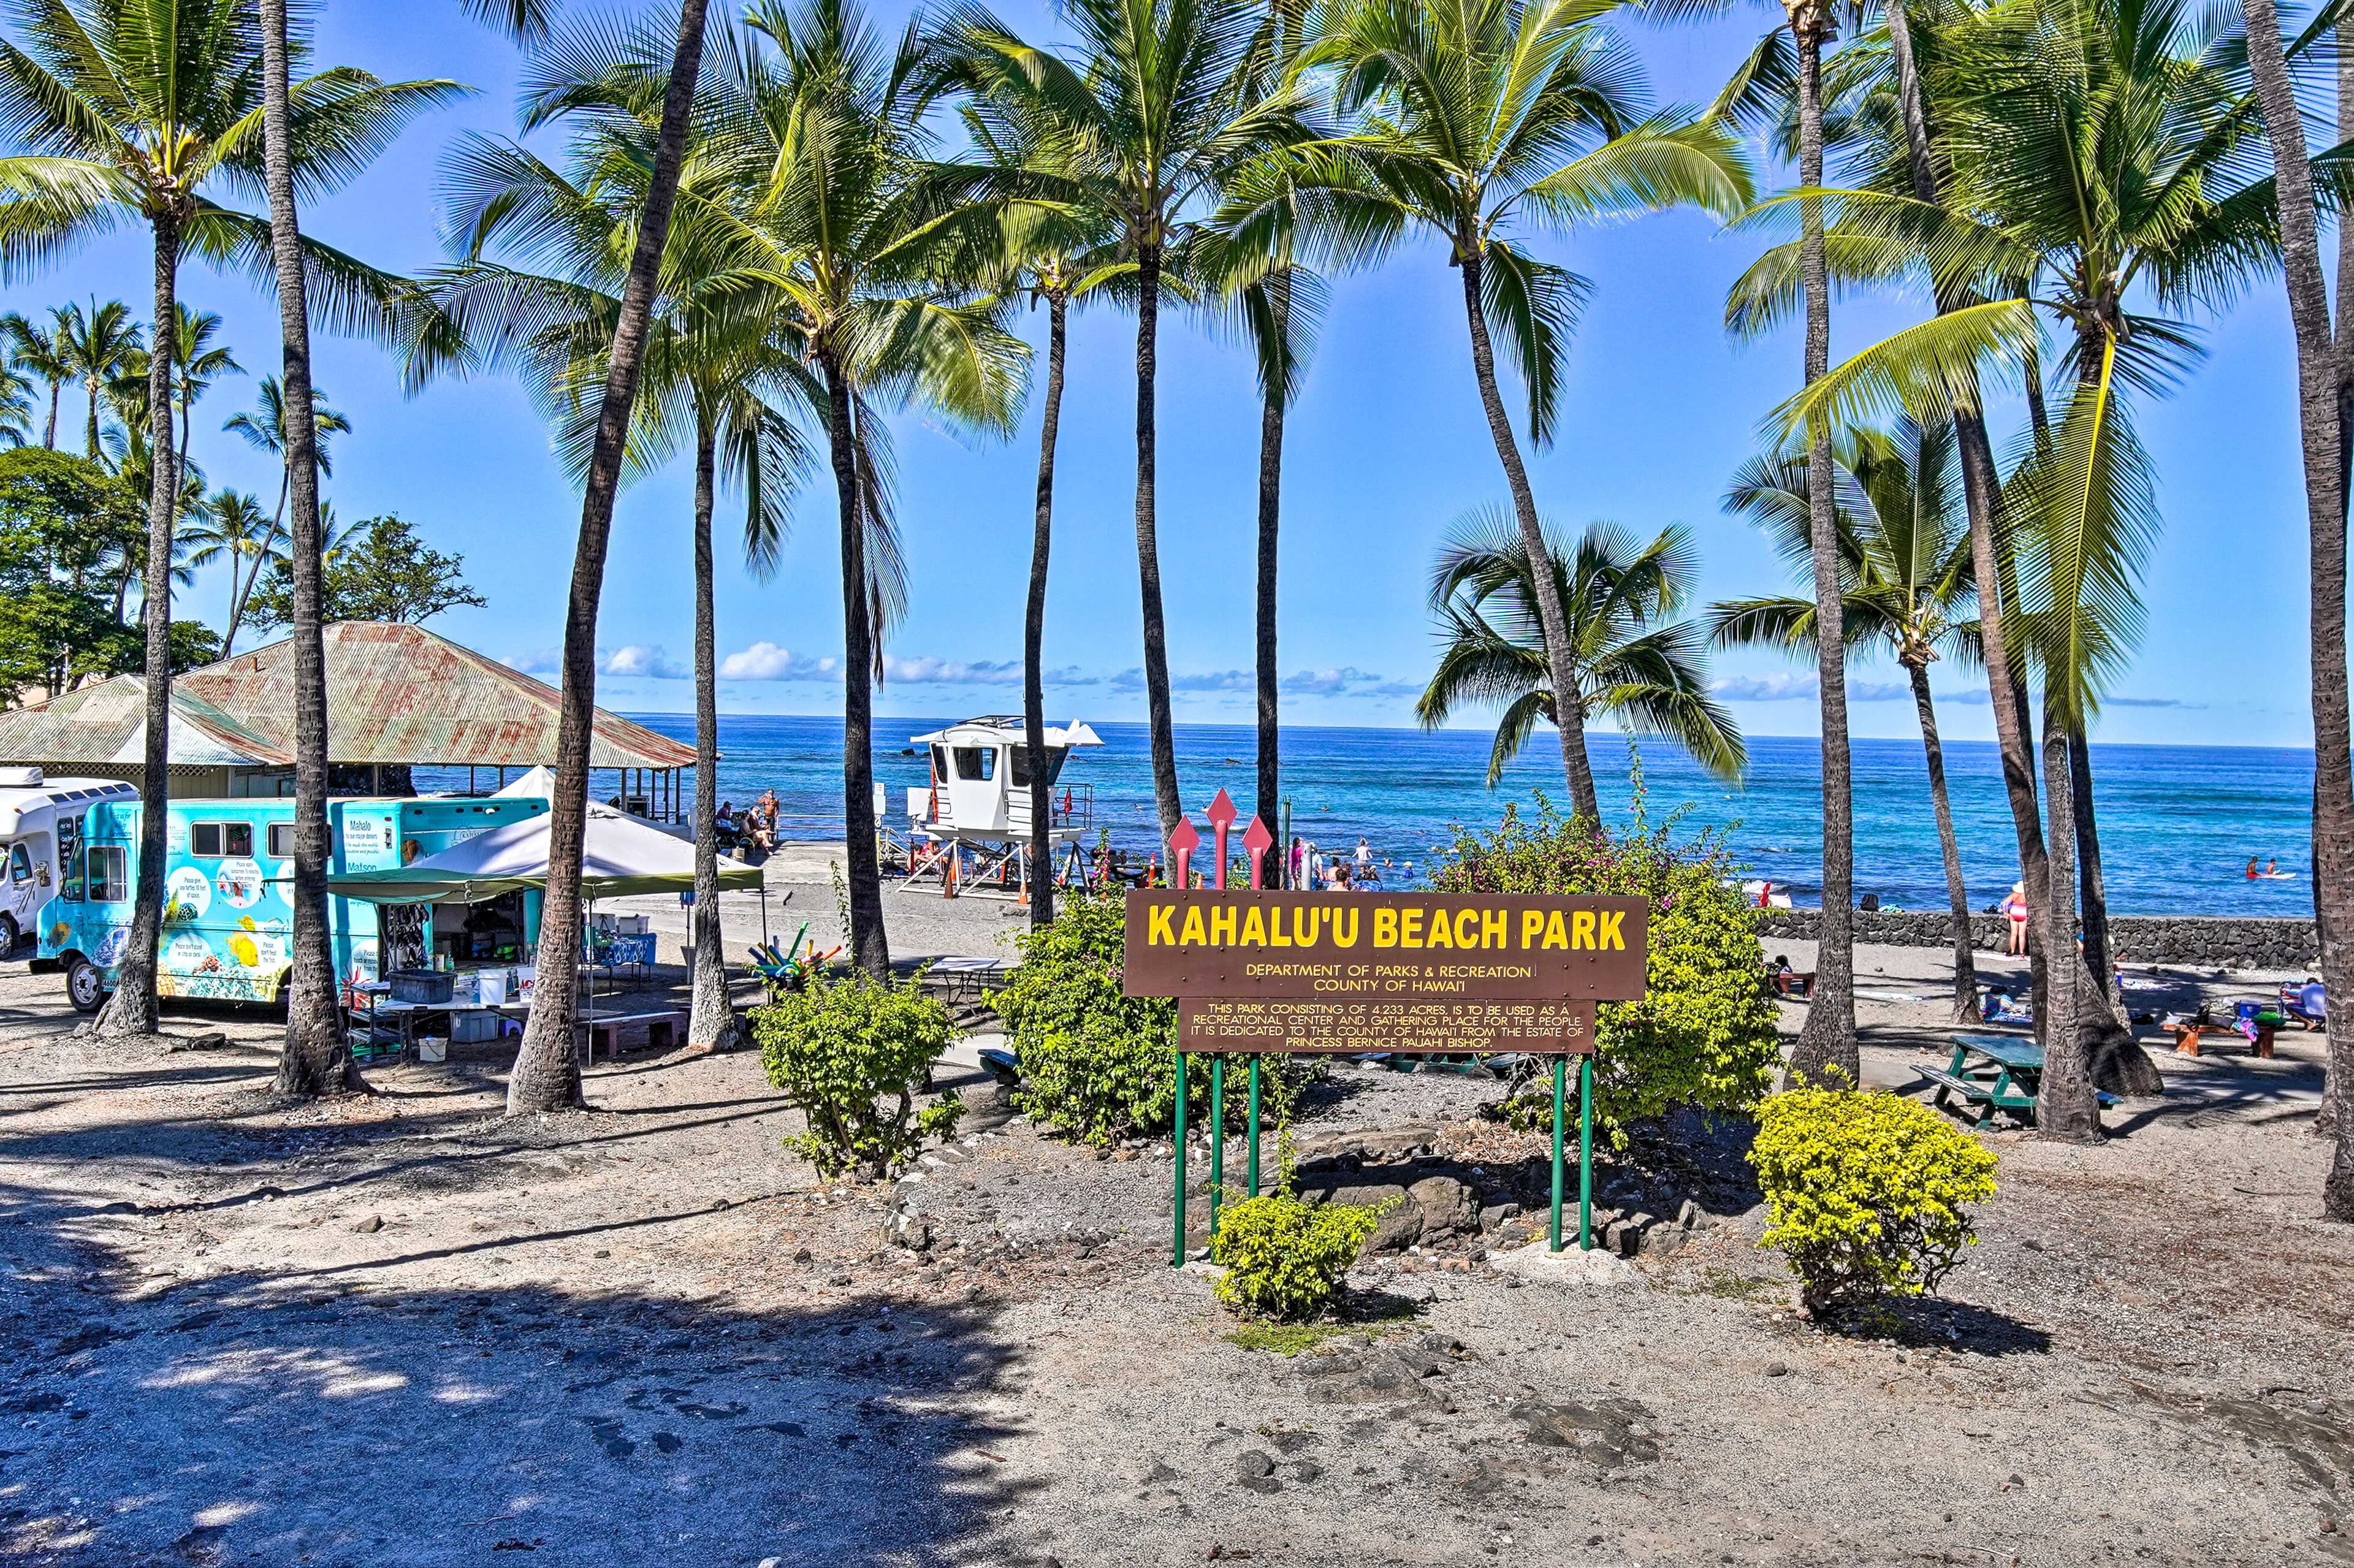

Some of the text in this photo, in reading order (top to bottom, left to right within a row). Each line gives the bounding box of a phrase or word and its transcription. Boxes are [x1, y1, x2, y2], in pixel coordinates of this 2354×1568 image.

[350, 820, 371, 831] Mahalo
[348, 862, 377, 872] Matson
[1148, 905, 1626, 950] KAHALU'U BEACH PARK
[1246, 964, 1531, 978] DEPARTMENT OF PARKS & RECREATION
[1314, 980, 1379, 991] COUNTY
[1385, 980, 1407, 991] OF
[1208, 1003, 1233, 1014] THIS
[1237, 1004, 1265, 1014] PARK
[1270, 1004, 1344, 1014] CONSISTING
[1349, 1005, 1366, 1014] OF
[1372, 1005, 1404, 1014] 4.233
[1453, 1005, 1462, 1015] IS
[1468, 1005, 1482, 1015] TO
[1488, 1006, 1501, 1015] BE
[1506, 1006, 1535, 1016] USED
[1539, 1006, 1555, 1016] AS
[1560, 1007, 1569, 1016] A
[1193, 1014, 1583, 1027] RECREATIONAL CENTER AND GATHERING PLACE FOR THE PEOPLE.
[1191, 1026, 1200, 1035] IT
[1206, 1026, 1215, 1035] IS
[1220, 1026, 1284, 1036] DEDICATED
[1289, 1026, 1305, 1036] TO
[1311, 1026, 1331, 1036] THE
[1336, 1026, 1388, 1037] COUNTY
[1394, 1027, 1411, 1037] OF
[1461, 1027, 1496, 1037] FROM
[1501, 1027, 1521, 1037] THE
[1526, 1027, 1561, 1037] ESTATE
[1567, 1027, 1584, 1037] OF
[1286, 1037, 1493, 1048] PRINCESS BERNICE PAUAHI BISHOP.
